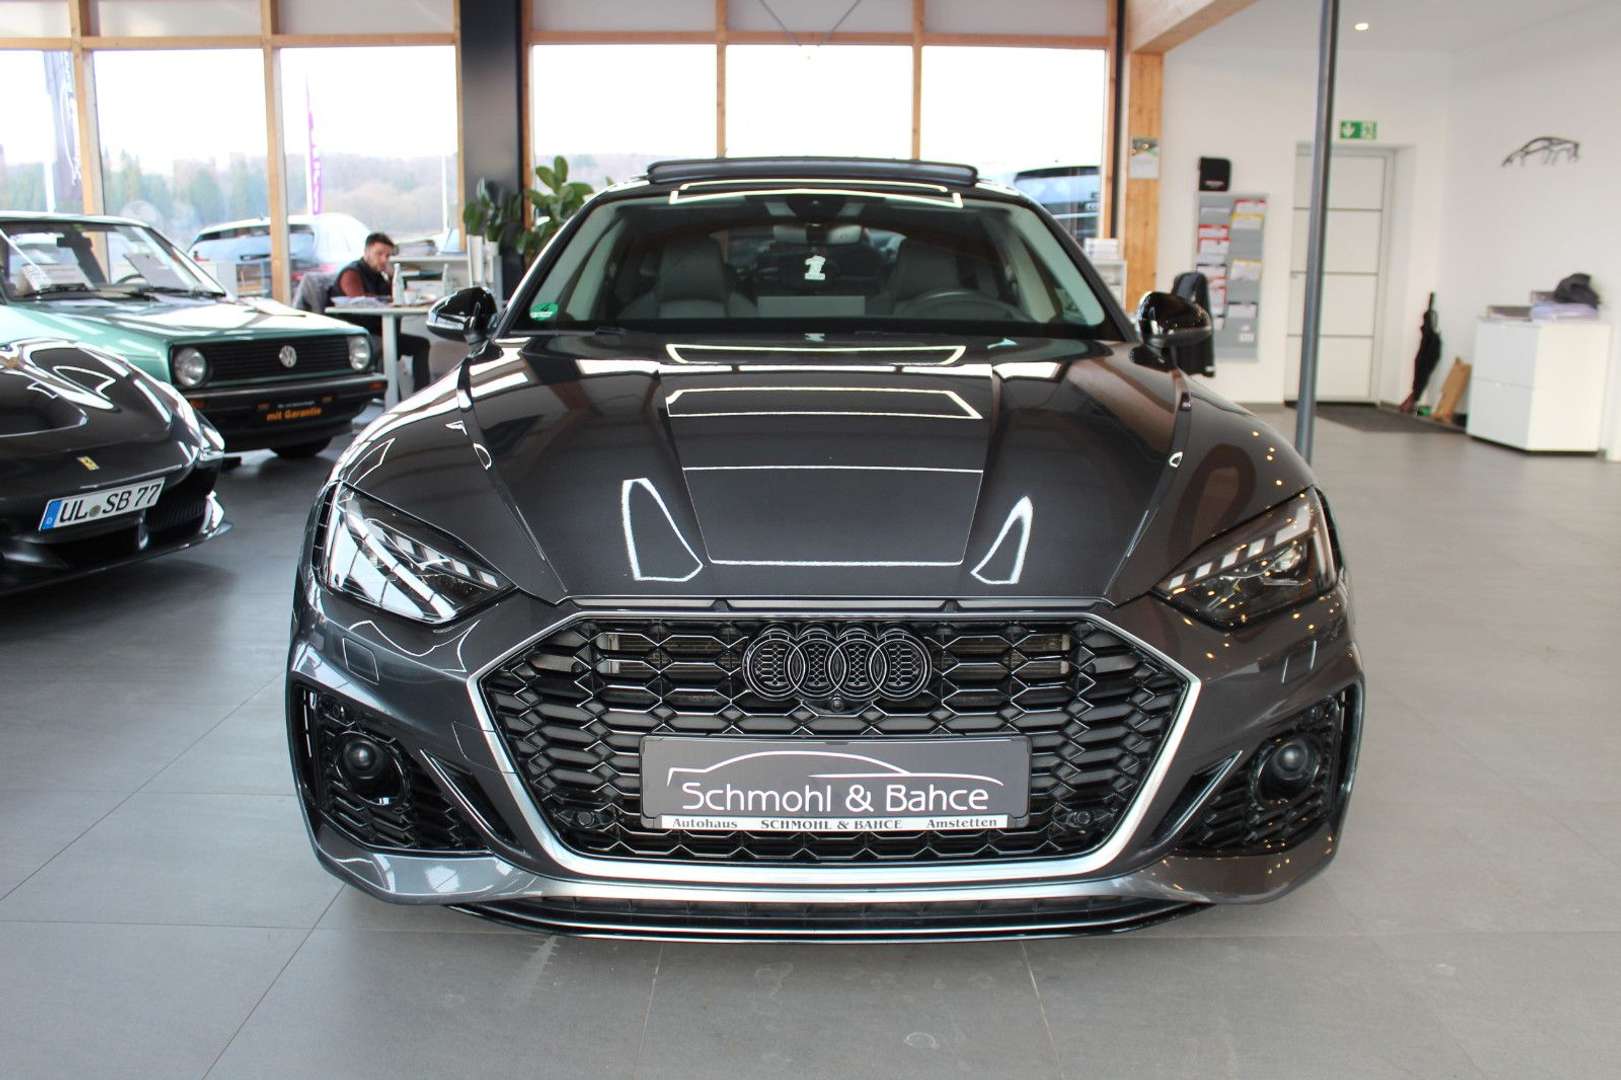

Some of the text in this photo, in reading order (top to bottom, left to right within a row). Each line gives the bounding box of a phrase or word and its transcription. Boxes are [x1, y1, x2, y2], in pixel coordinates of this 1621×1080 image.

[266, 406, 322, 421] mit Garantie
[59, 484, 161, 523] UL SB 77
[682, 782, 989, 812] Schmohl & Bahce
[672, 818, 998, 829] Autohaus SCHMOHL & BAHCE Amstetten
